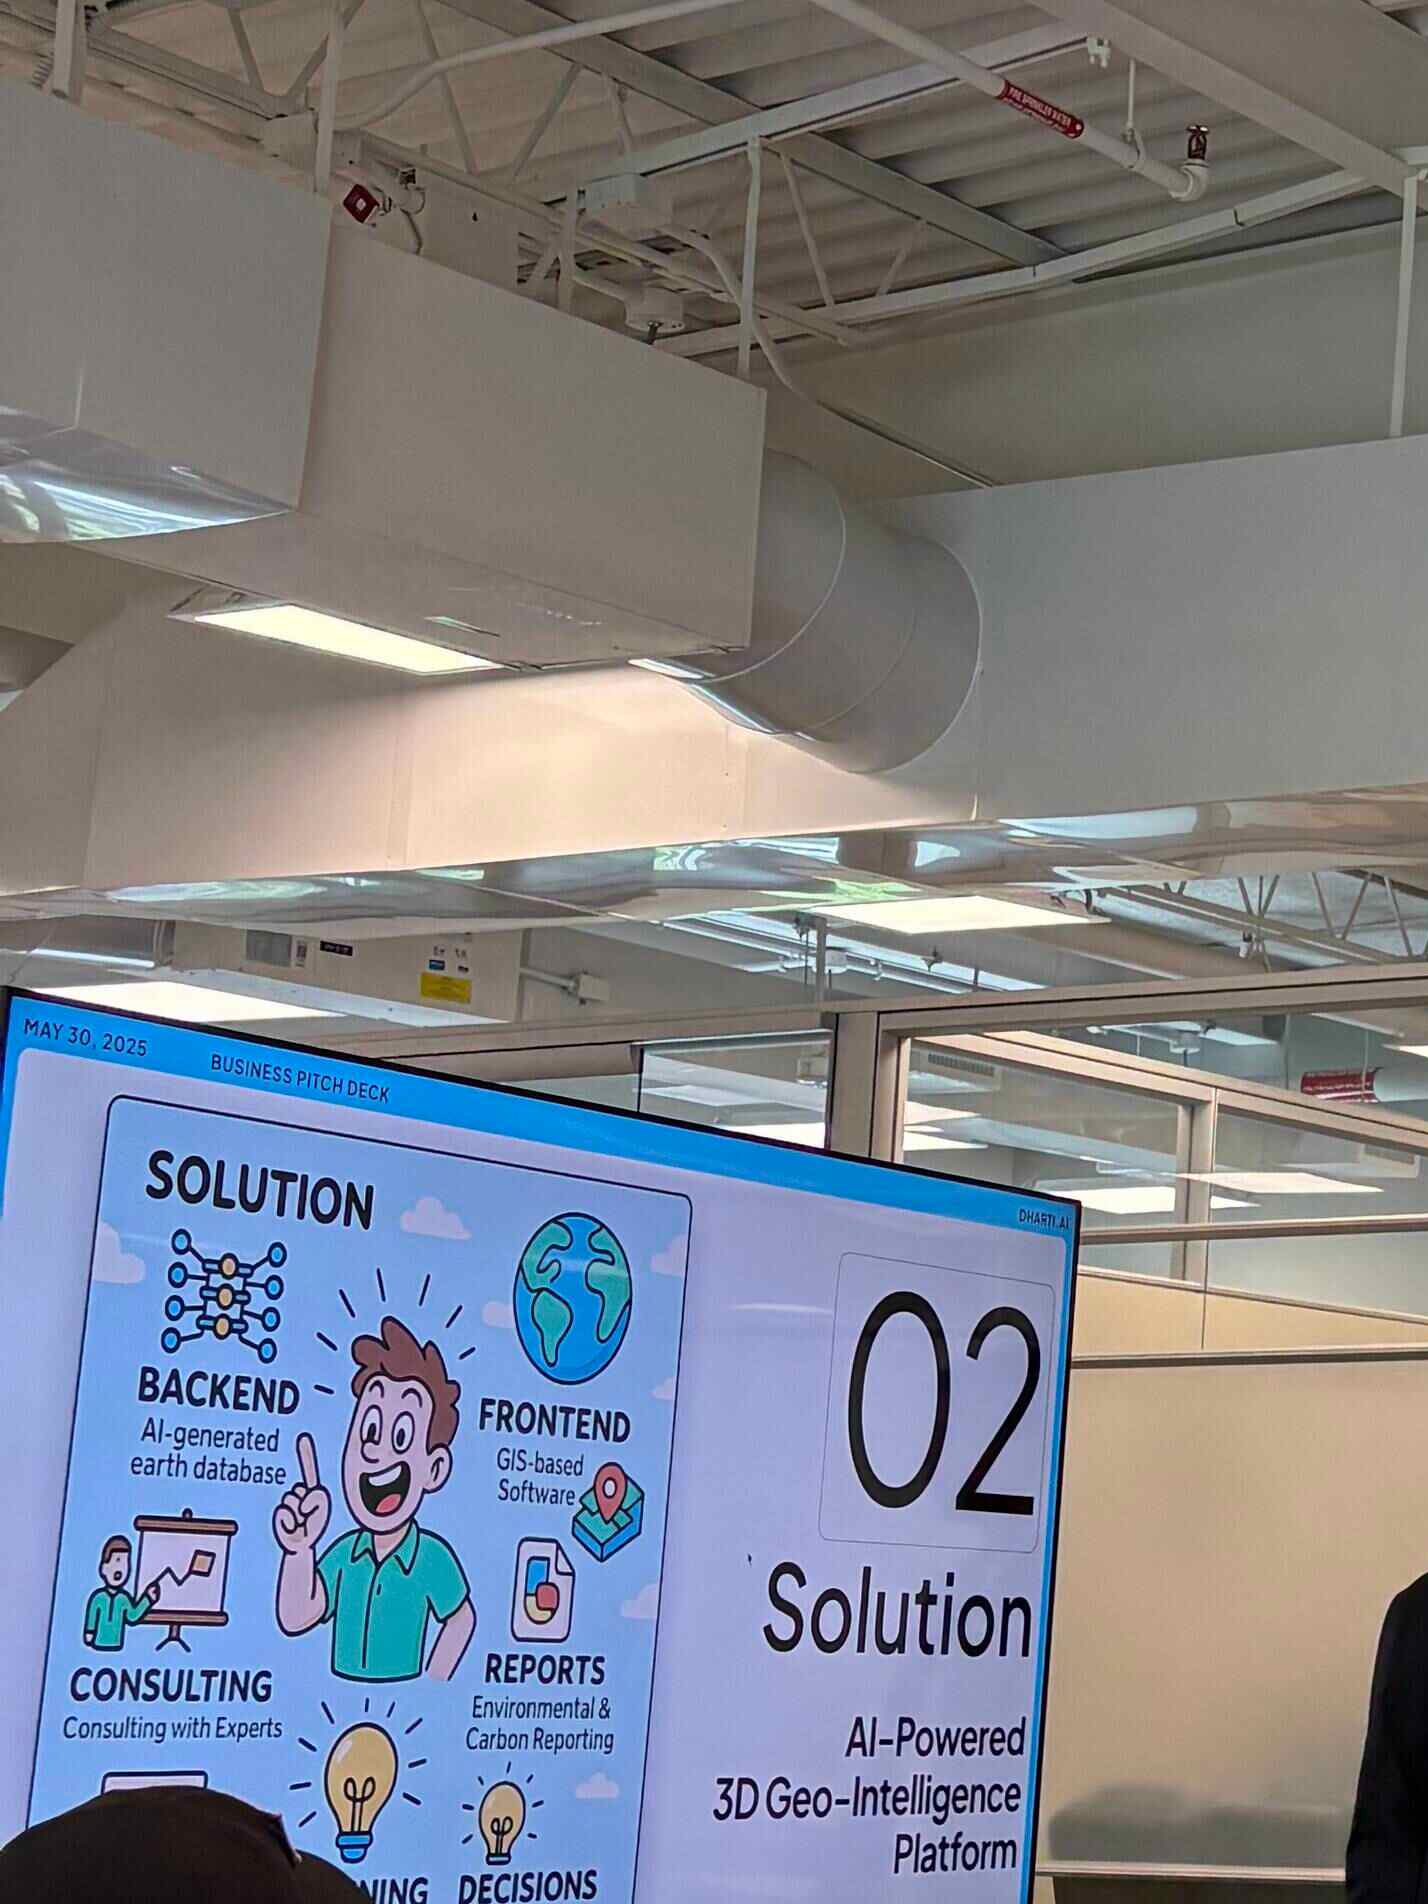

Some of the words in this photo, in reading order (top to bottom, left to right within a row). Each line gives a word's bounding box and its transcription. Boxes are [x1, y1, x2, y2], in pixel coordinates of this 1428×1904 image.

[24, 1018, 63, 1040] MAY
[68, 1026, 97, 1049] 30,
[103, 1033, 147, 1056] 2025
[211, 1054, 292, 1084] BUSINESS
[297, 1070, 343, 1094] PITCH
[347, 1080, 390, 1103] DECK
[146, 1150, 374, 1230] SOLUTION
[138, 1366, 300, 1414] BACKEND
[848, 1291, 1040, 1515] 02
[141, 1417, 280, 1452] AI-generated
[479, 1398, 631, 1443] FRONTEND
[131, 1453, 188, 1478] earth
[193, 1455, 287, 1485] database
[497, 1447, 584, 1476] GIS-based
[498, 1478, 576, 1506] Software
[763, 1561, 1032, 1658] Solution
[70, 1667, 272, 1702] CONSULTING
[485, 1653, 605, 1684] REPORTS
[472, 1695, 595, 1719] Environmental
[598, 1697, 611, 1719] &
[63, 1716, 166, 1744] Consulting
[172, 1716, 210, 1738] with
[215, 1717, 283, 1742] Experts
[466, 1726, 528, 1750] Carbon
[533, 1727, 614, 1755] Reporting
[845, 1716, 1026, 1757] AI-Powered
[713, 1777, 760, 1821] 3D
[766, 1774, 1021, 1826] Geo-Intelligence
[894, 1831, 1017, 1874] Platform
